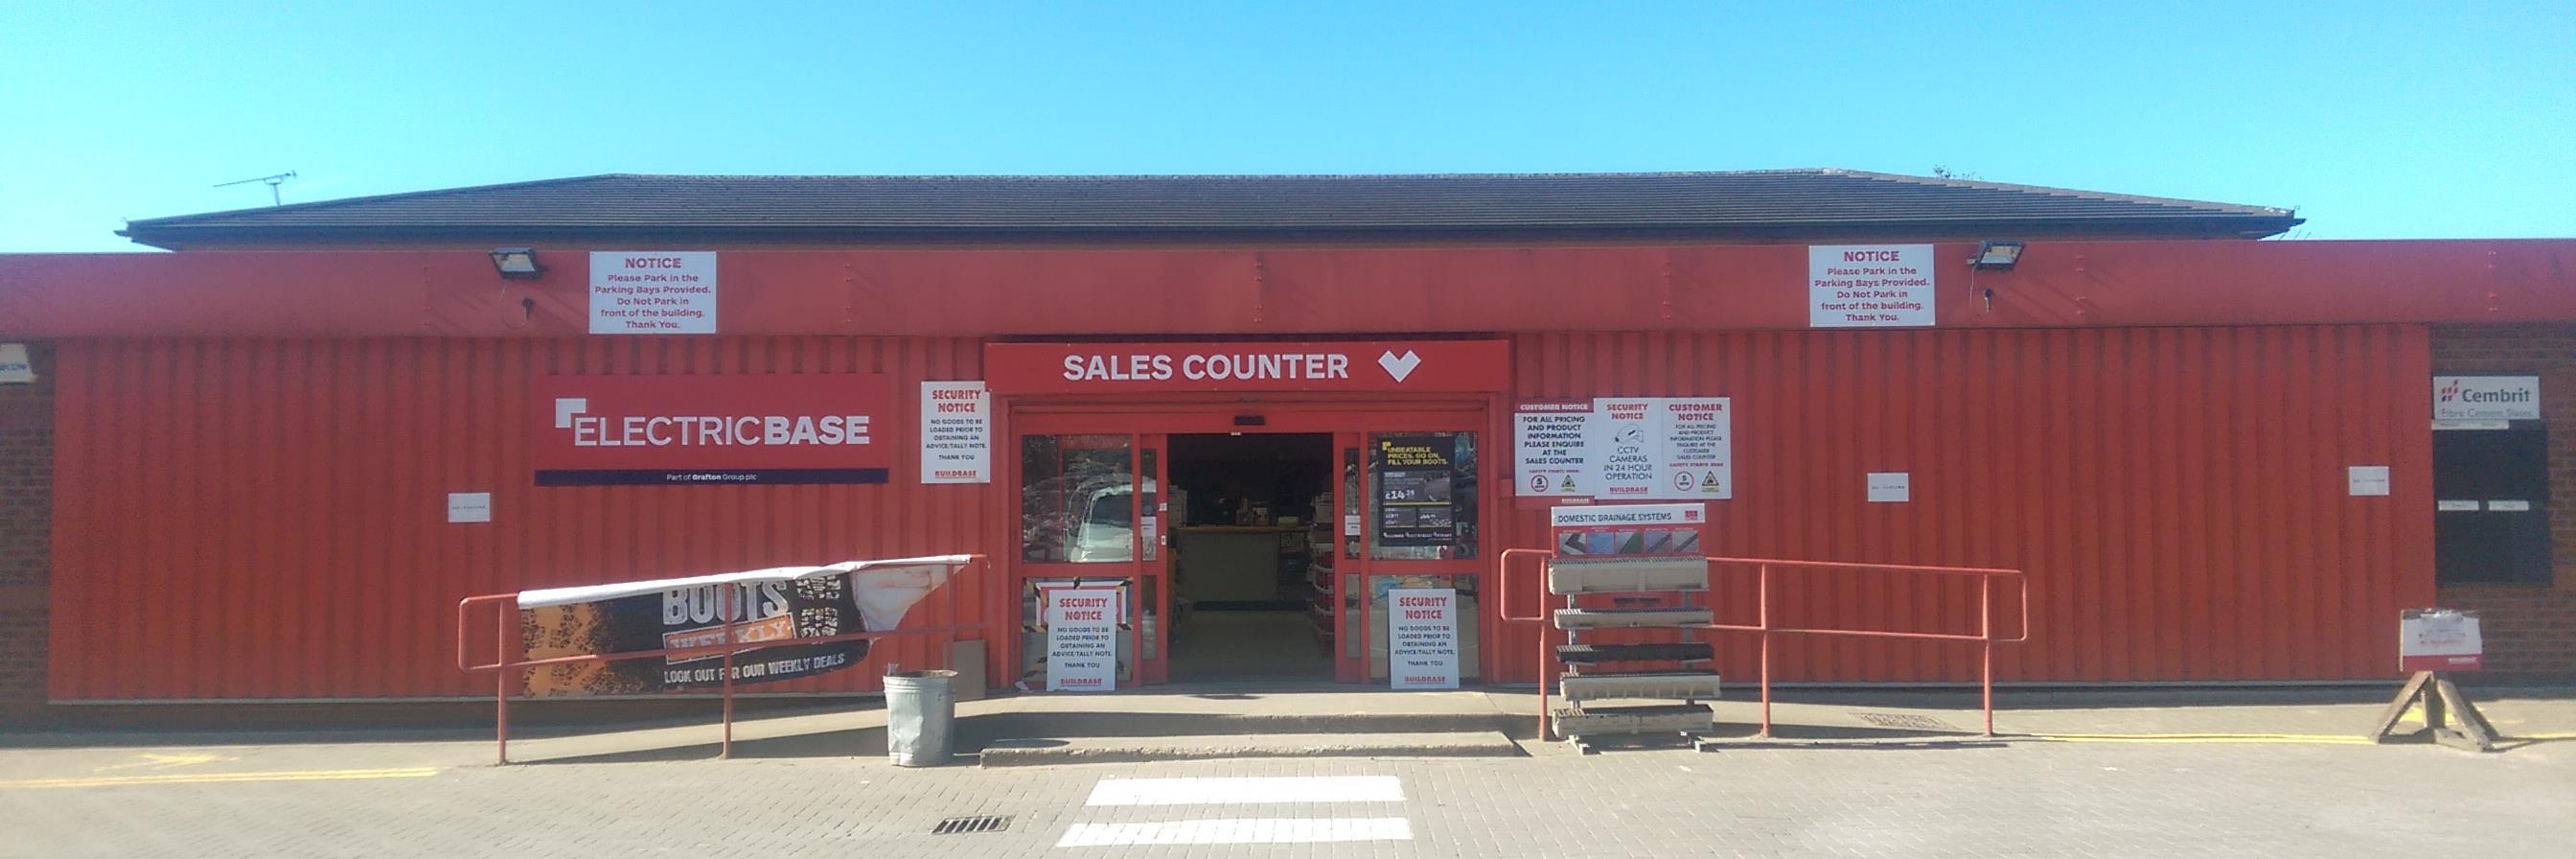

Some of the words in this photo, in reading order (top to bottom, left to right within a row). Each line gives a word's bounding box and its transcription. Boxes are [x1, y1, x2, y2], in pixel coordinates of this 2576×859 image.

[1844, 251, 1899, 262] NOTICE
[625, 258, 681, 268] NOTICE
[1815, 279, 1852, 288] Parking
[1855, 279, 1878, 288] Bays
[1882, 278, 1929, 287] Provided.
[595, 286, 633, 294] Parking
[636, 286, 660, 294] Bays
[663, 286, 711, 294] Provided.
[1822, 302, 1846, 311] front
[1849, 302, 1859, 311] of
[1862, 302, 1878, 311] the
[642, 309, 658, 317] the
[1064, 355, 1173, 381] SALES
[1183, 354, 1348, 380] COUNTER
[932, 390, 981, 400] SECURITY
[2463, 388, 2530, 403] Cembrit
[938, 404, 976, 412] NOTICE
[575, 415, 869, 446] ELECTRICBASE
[663, 580, 789, 624] BOOTS
[1059, 598, 1108, 608] SECURITY
[1400, 597, 1447, 607] SECURITY
[1066, 612, 1102, 620] NOTICE
[1406, 611, 1442, 619] NOTICE
[664, 671, 692, 684] LOOK
[695, 670, 715, 682] OUT
[719, 667, 740, 681] FR
[743, 665, 766, 677] OUR
[769, 659, 811, 674] WEEKLY
[815, 653, 845, 668] DEALS
